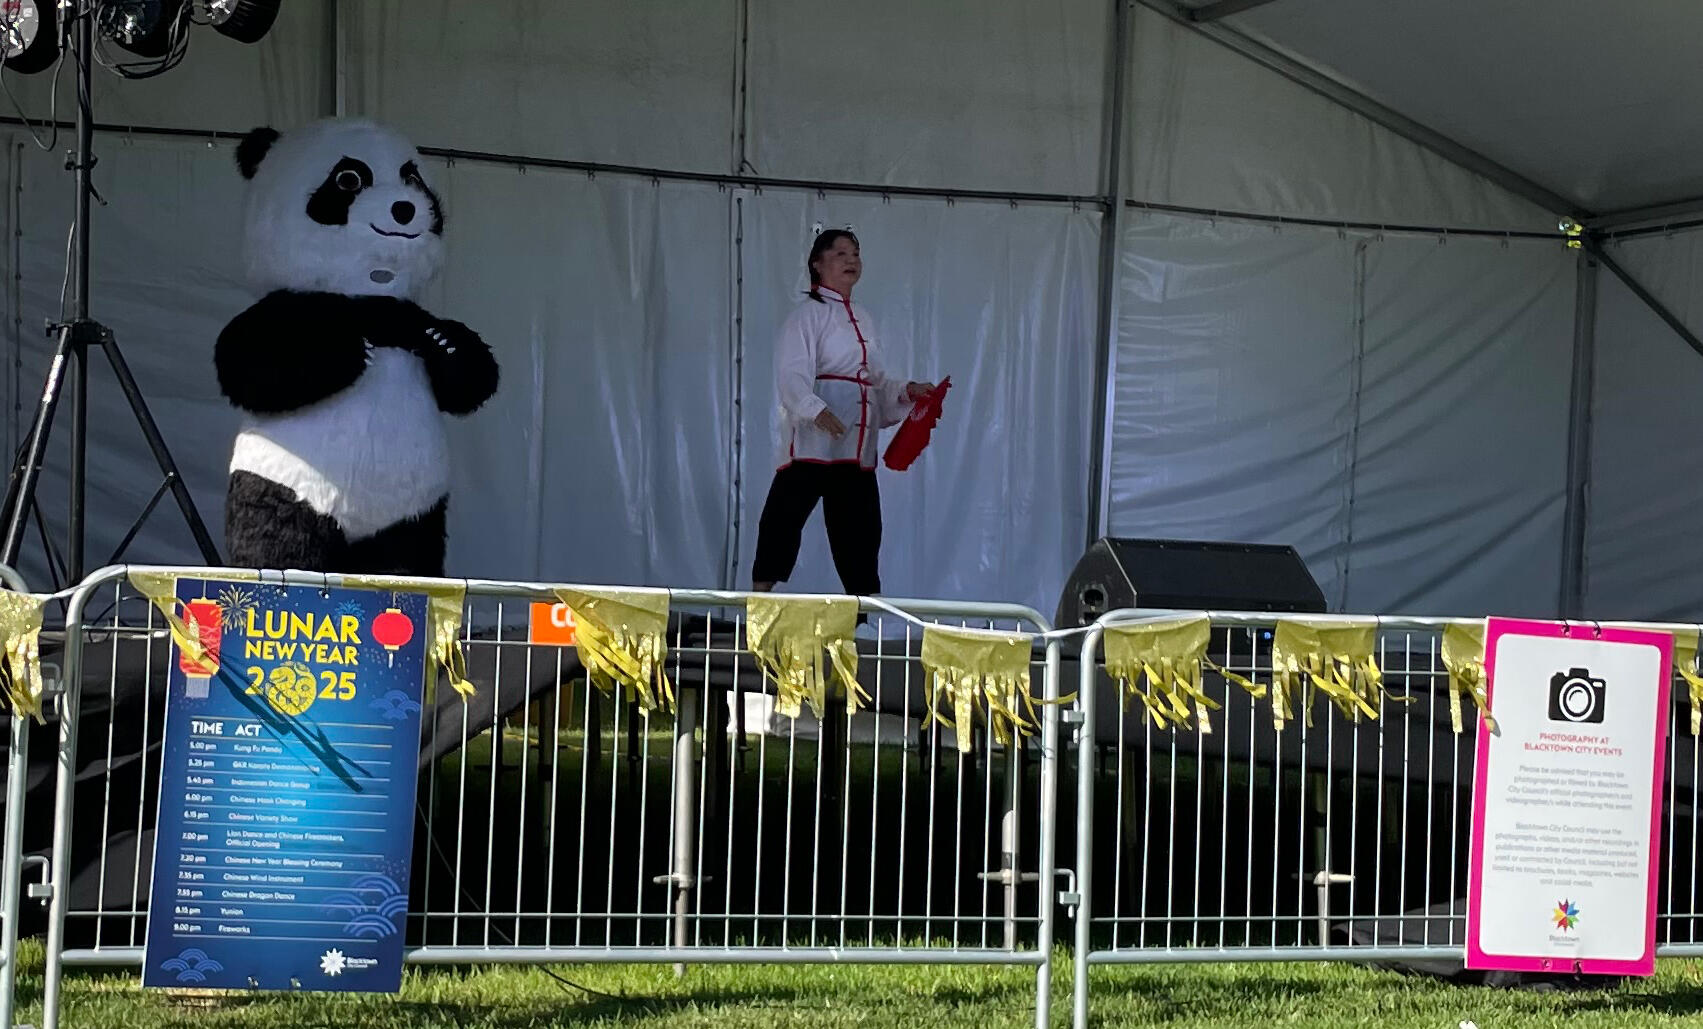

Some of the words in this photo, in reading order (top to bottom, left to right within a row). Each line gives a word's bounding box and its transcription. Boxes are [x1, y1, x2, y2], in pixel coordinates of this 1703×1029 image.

[246, 607, 361, 644] LUNAR
[245, 640, 297, 661] NEW
[300, 642, 359, 666] YEAR
[191, 721, 224, 735] TIME
[235, 724, 262, 736] ACT
[1539, 733, 1598, 744] PHOTOGRAPHY
[205, 743, 217, 751] pm
[234, 744, 251, 753] Kung
[252, 744, 260, 752] Fu
[261, 745, 282, 753] Panda
[1524, 742, 1573, 753] BLACKTOWN
[1575, 746, 1592, 754] CITY
[1594, 747, 1622, 756] EVENTS
[231, 778, 267, 786] Indonesian
[290, 781, 310, 790] Group
[230, 795, 255, 803] Chinese
[275, 797, 306, 807] Changing
[197, 812, 209, 820] pm
[255, 814, 279, 823] Variety
[182, 832, 196, 840] 7.00
[278, 832, 303, 840] Chinese
[251, 840, 280, 849] Opening
[225, 856, 250, 864] Chinese
[283, 858, 310, 867] Blessing
[311, 859, 343, 868] Ceremony
[223, 873, 249, 881] Chinese
[268, 874, 304, 882] Instrument
[222, 890, 248, 898] Chinese
[248, 891, 273, 900] Dragon
[274, 892, 295, 900] Dance
[219, 924, 250, 934] Fireworks
